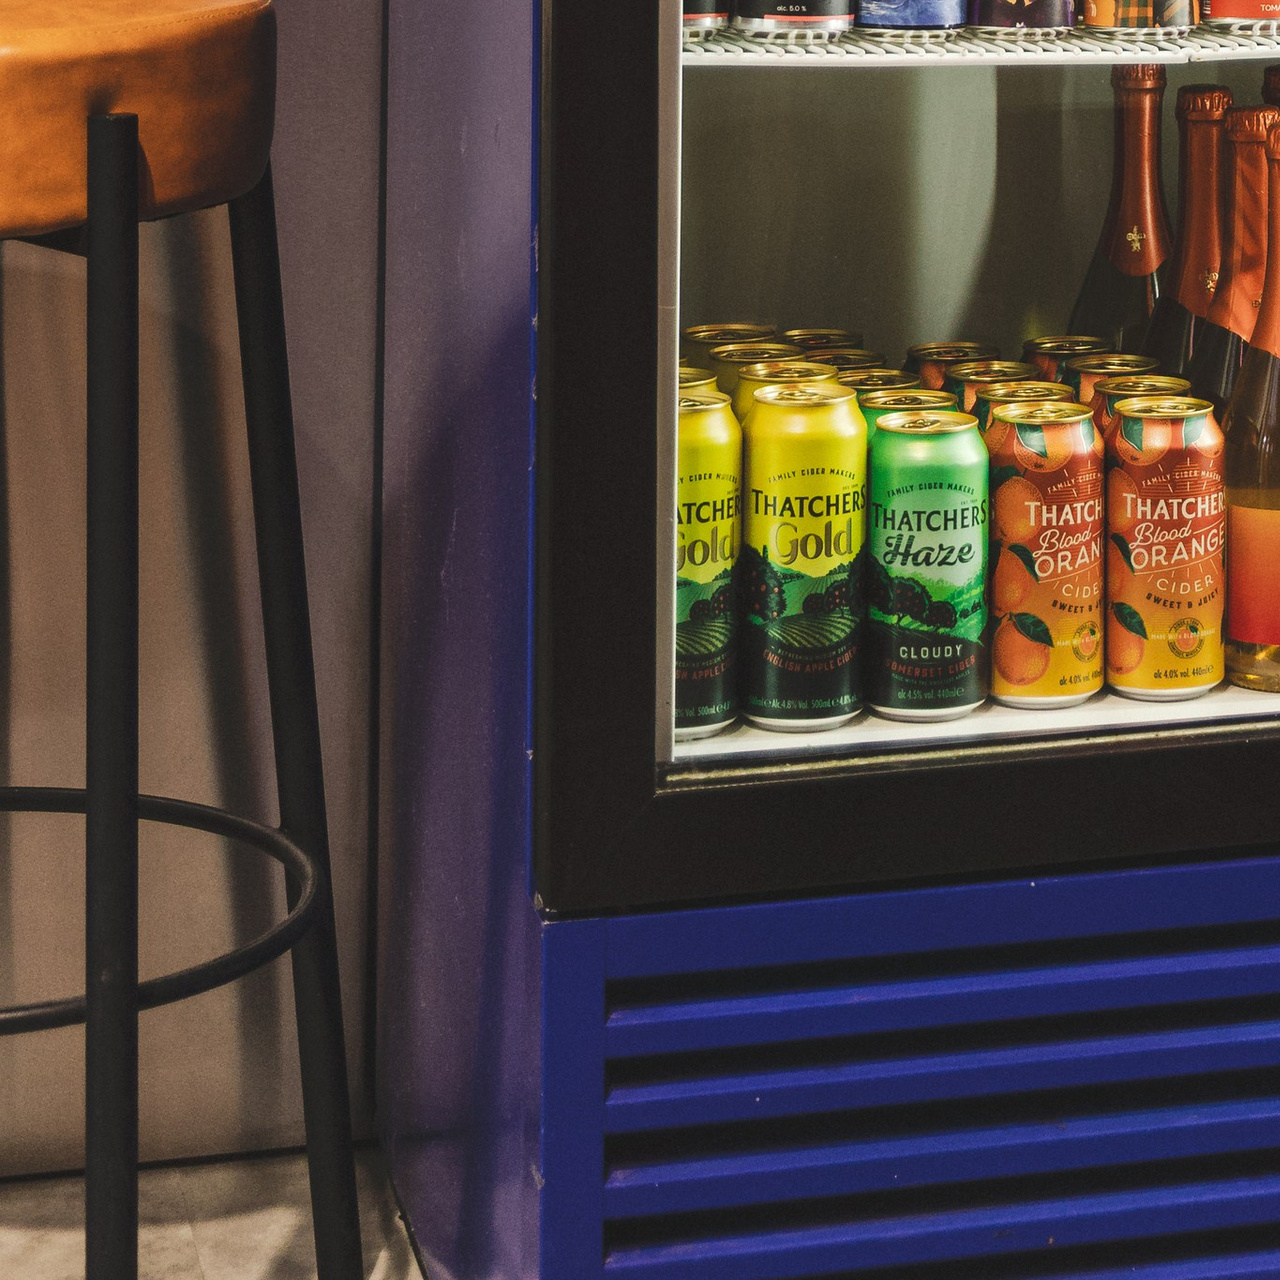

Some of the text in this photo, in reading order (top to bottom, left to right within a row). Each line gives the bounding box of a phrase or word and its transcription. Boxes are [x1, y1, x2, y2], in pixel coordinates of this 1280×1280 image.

[768, 467, 856, 485] FAMILY CIDER MAKERS
[1047, 478, 1076, 495] FAMILY
[1141, 469, 1221, 489] FAMILY CIDER MAKERS
[751, 483, 866, 519] THATCHERS
[886, 482, 975, 498] FAMILY CIDER MAKERS
[872, 498, 988, 533] THATCHERS
[774, 516, 854, 567] Gold
[1033, 523, 1093, 559] Blood
[1130, 520, 1192, 553] Blood
[883, 533, 976, 568] Haze
[1130, 528, 1225, 571] ORANGE
[1157, 574, 1215, 596] CIDER
[1052, 599, 1084, 614] SWEET
[1146, 588, 1220, 610] SWEET JUICY
[763, 648, 801, 673] ENGLISH
[805, 658, 834, 673] APPLE
[899, 644, 963, 659] CLOUDY
[949, 655, 976, 673] CIDER
